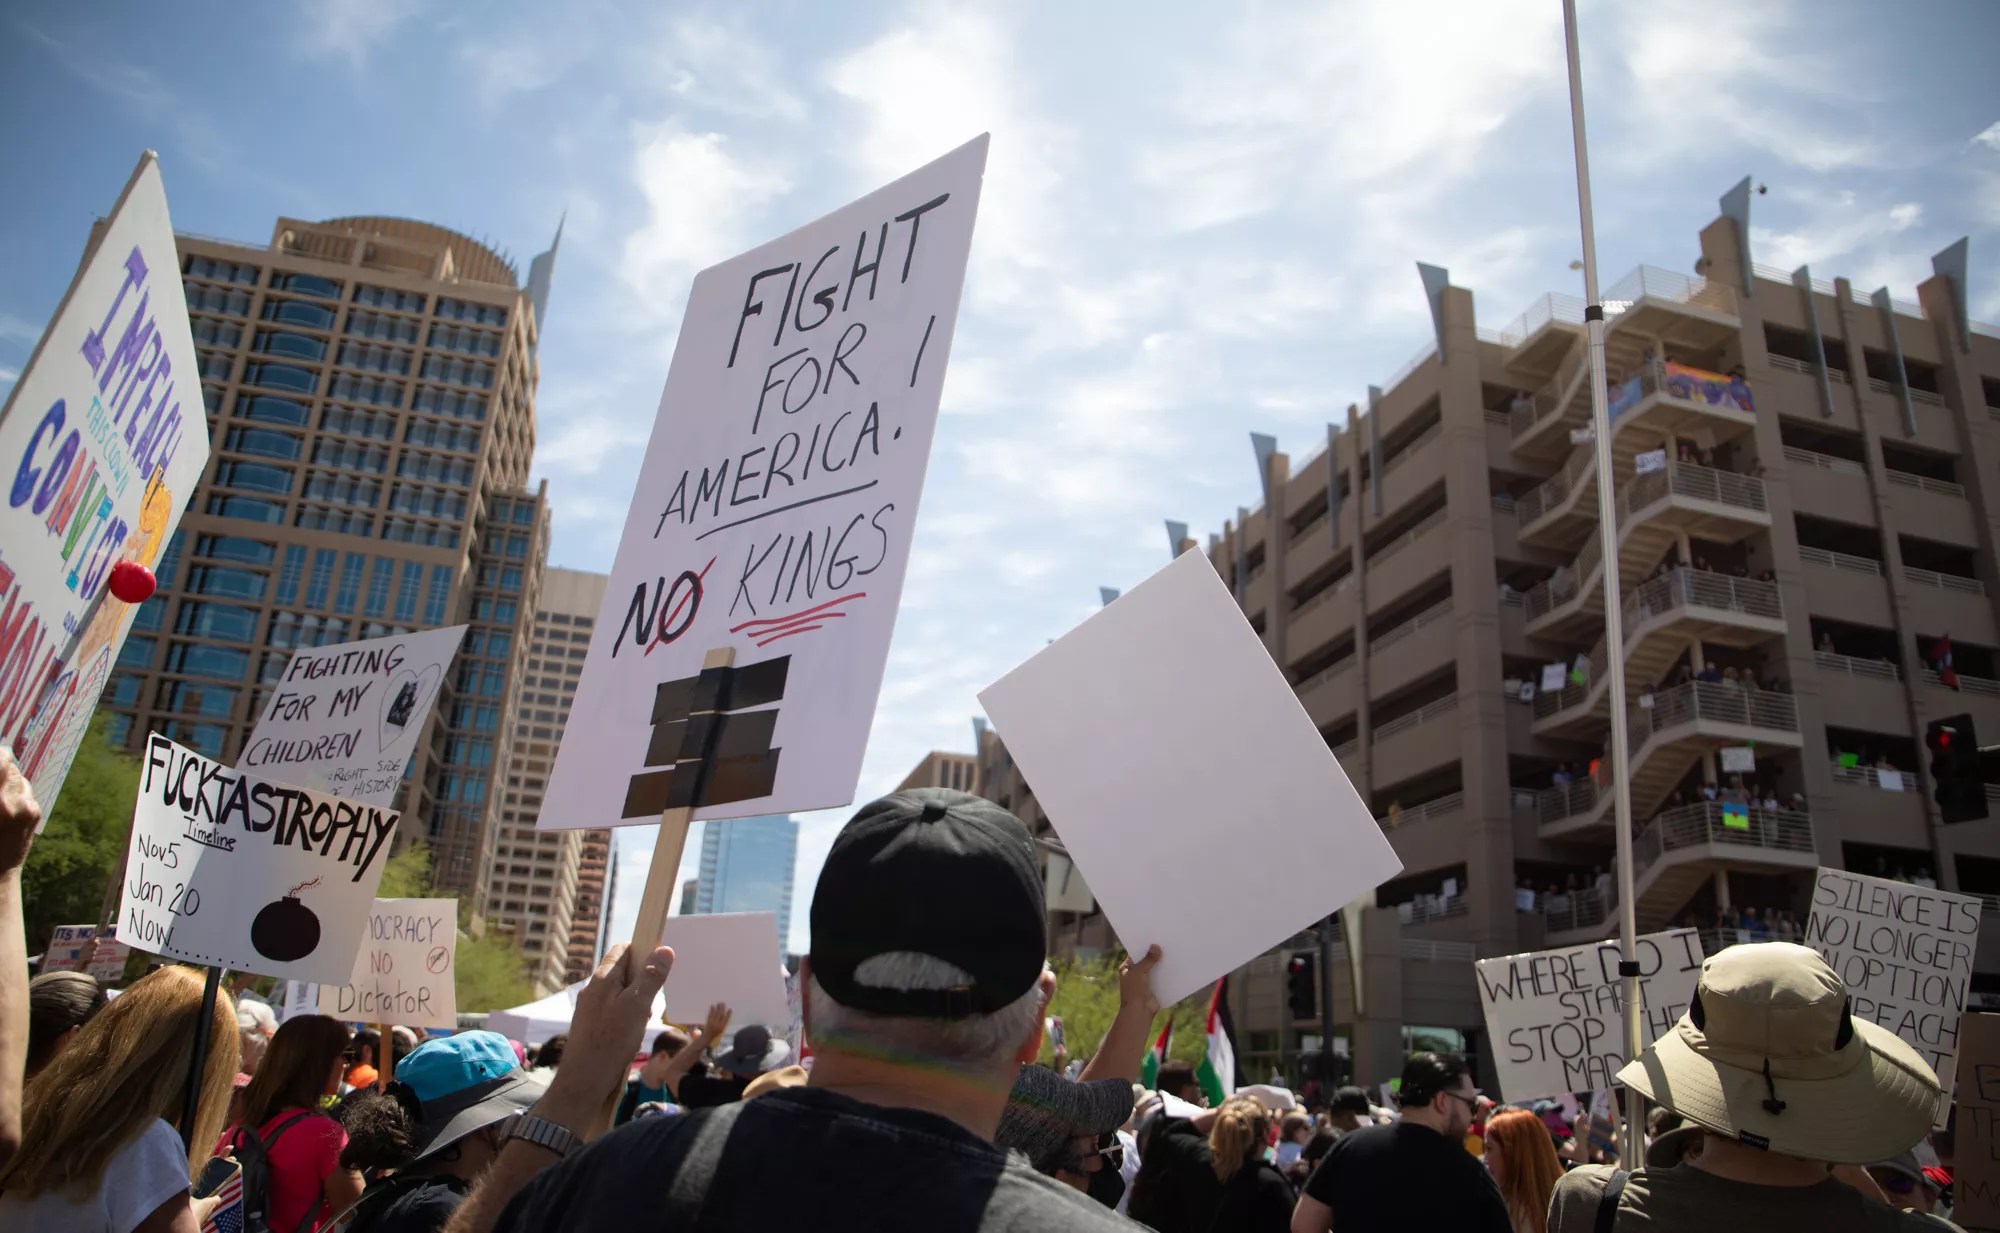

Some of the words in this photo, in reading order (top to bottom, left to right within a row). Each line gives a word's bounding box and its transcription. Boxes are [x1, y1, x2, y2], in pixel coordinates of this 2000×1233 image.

[727, 193, 951, 368] FIGHT
[79, 244, 183, 510] IMPEACH
[753, 322, 868, 434] FOR
[86, 394, 109, 444] THIS
[9, 398, 128, 600] CONVICT
[612, 560, 714, 658] NO
[729, 503, 895, 618] KINGS
[287, 643, 405, 682] FIGHTING
[269, 692, 317, 722] FOR
[328, 680, 373, 718] MY
[246, 728, 362, 767] CHILDREN
[333, 767, 369, 782] RIGHT
[377, 759, 401, 772] SIDE
[145, 736, 399, 882] FUCKTASTROPHY
[351, 775, 400, 797] HISTORY
[183, 815, 238, 850] Timeline
[130, 862, 163, 907] Jan
[168, 882, 201, 917] 20
[1814, 873, 1935, 928] SILENCE
[1937, 899, 1981, 935] IS
[370, 951, 394, 975] NO
[1477, 951, 1593, 1004] WHERE
[1598, 939, 1664, 985] DO
[1671, 930, 1703, 973] I
[1806, 911, 1850, 947] NO
[1853, 920, 1971, 975] LONGER
[1843, 954, 1966, 1012] OPTION
[1508, 1017, 1606, 1064] STOP
[1639, 1002, 1688, 1043] HE
[1845, 994, 1961, 1050] PEACH
